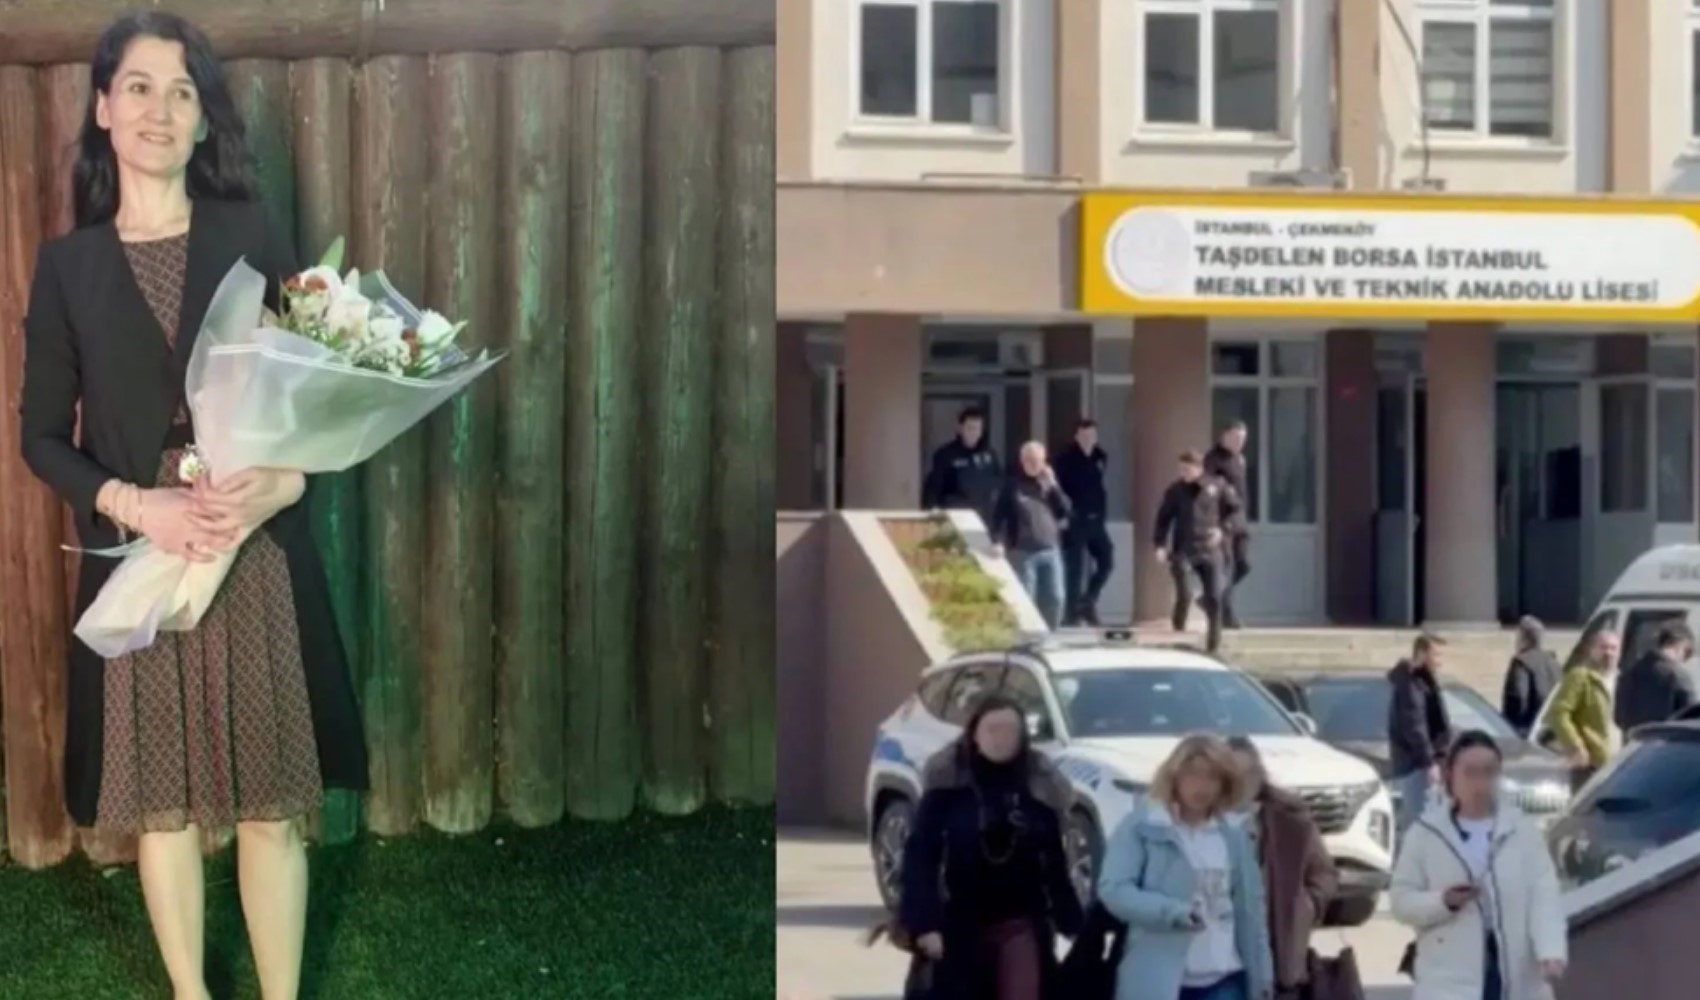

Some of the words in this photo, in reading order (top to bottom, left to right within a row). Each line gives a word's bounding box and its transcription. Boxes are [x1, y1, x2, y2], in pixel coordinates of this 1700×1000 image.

[1195, 246, 1323, 270] TAŞDELEN
[1333, 247, 1418, 268] BORSA
[1427, 244, 1548, 270] İSTANBUL
[1195, 275, 1304, 296] MESLEKİ
[1314, 279, 1346, 297] VE
[1354, 277, 1448, 299] TEKNİK
[1457, 281, 1573, 301] ANADOLU
[1582, 278, 1659, 301] LİSESİ
